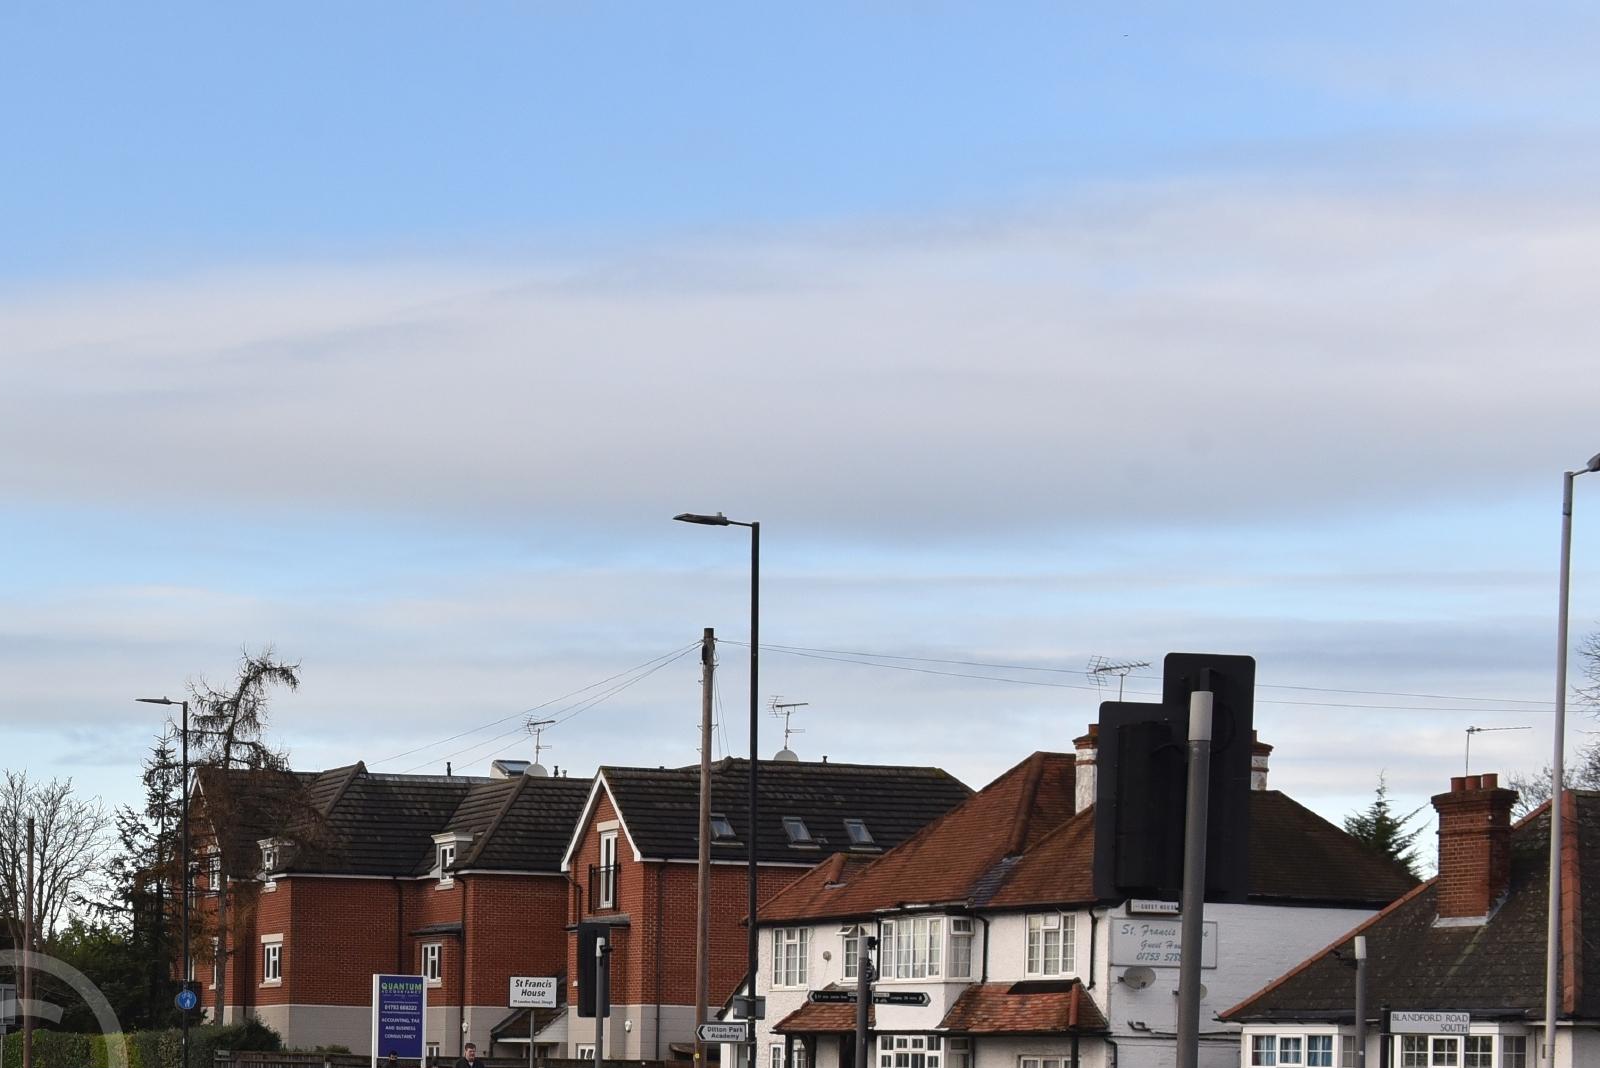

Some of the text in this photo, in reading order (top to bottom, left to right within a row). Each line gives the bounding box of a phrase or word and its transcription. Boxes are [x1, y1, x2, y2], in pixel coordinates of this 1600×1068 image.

[1121, 923, 1176, 937] St. Francis
[1136, 952, 1161, 961] 01753
[381, 982, 422, 990] QUANTUM
[515, 979, 552, 988] St Francis
[521, 989, 546, 997] House
[1391, 1013, 1469, 1022] BLANDFORD ROAD
[1440, 1023, 1468, 1032] SOUTH
